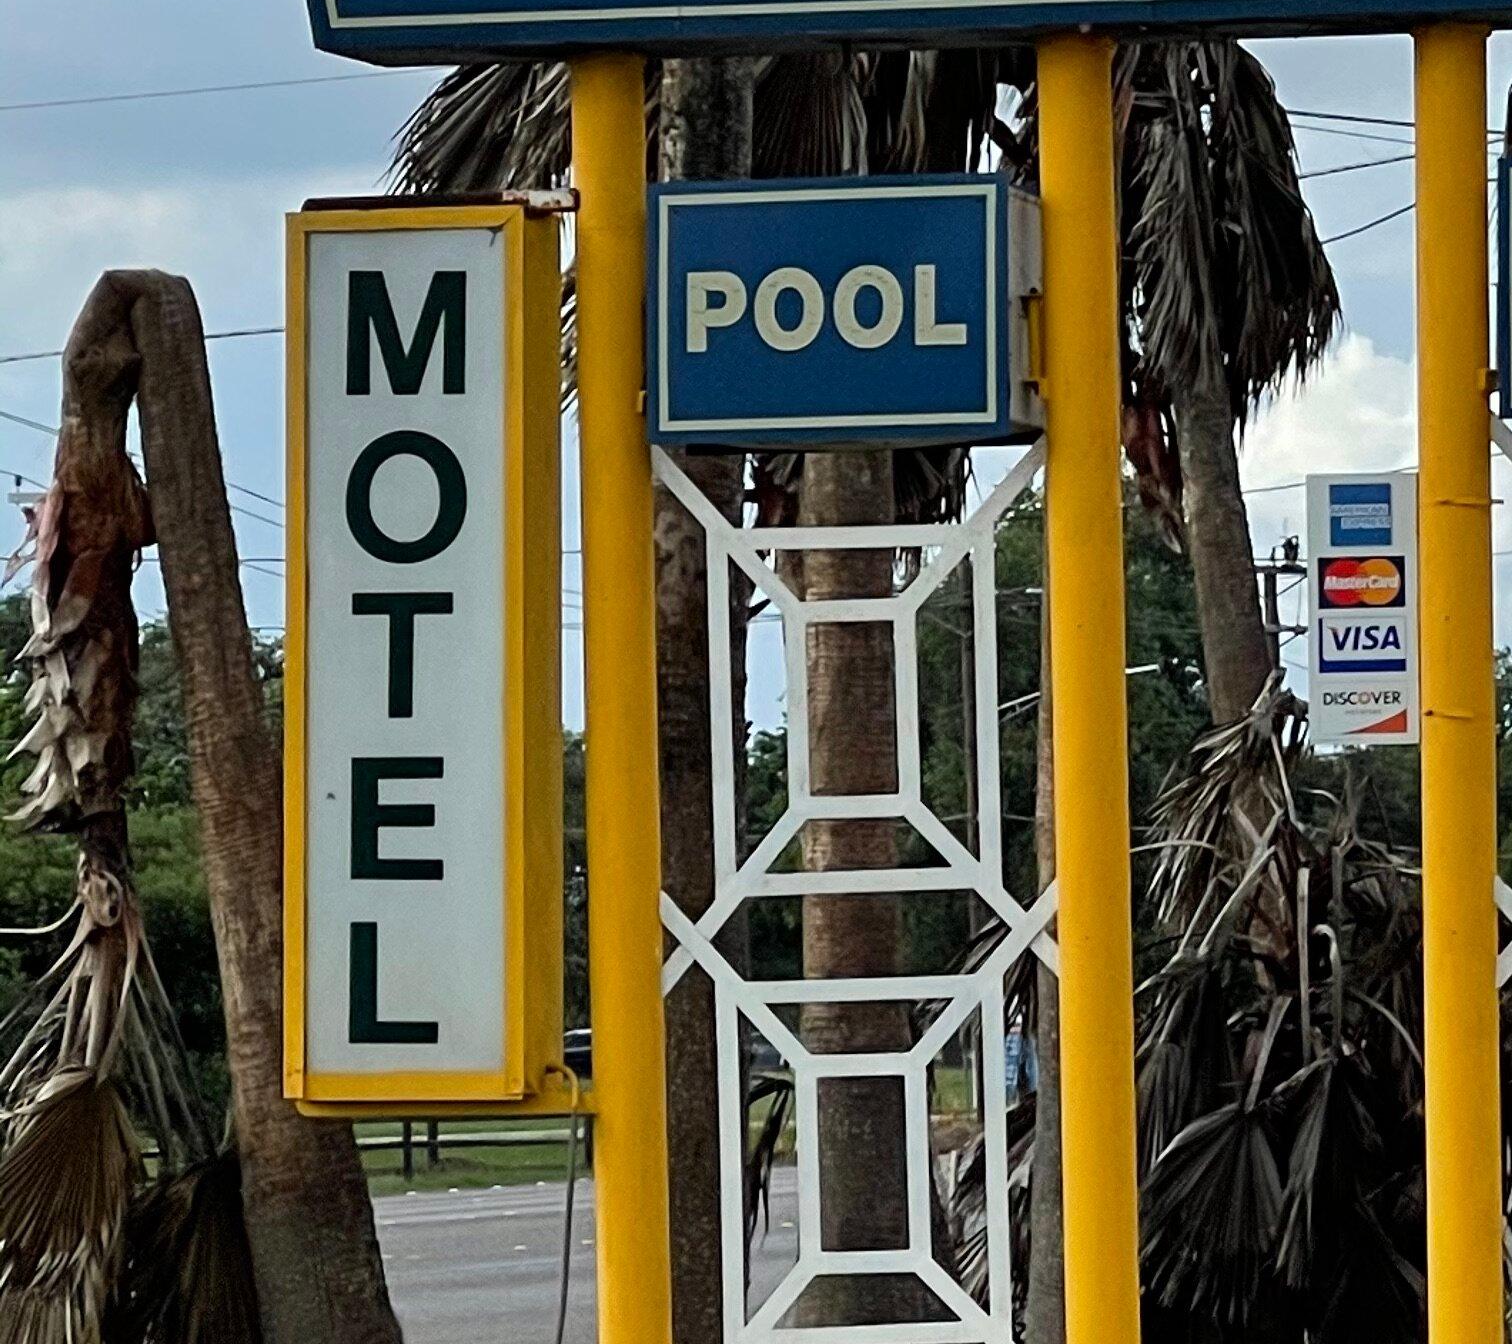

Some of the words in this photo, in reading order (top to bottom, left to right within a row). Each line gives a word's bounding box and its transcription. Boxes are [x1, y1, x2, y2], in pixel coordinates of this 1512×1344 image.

[685, 263, 967, 353] POOL
[345, 269, 468, 1045] MOTEL
[1327, 625, 1400, 651] VISA
[1323, 691, 1401, 705] DISCOVER
